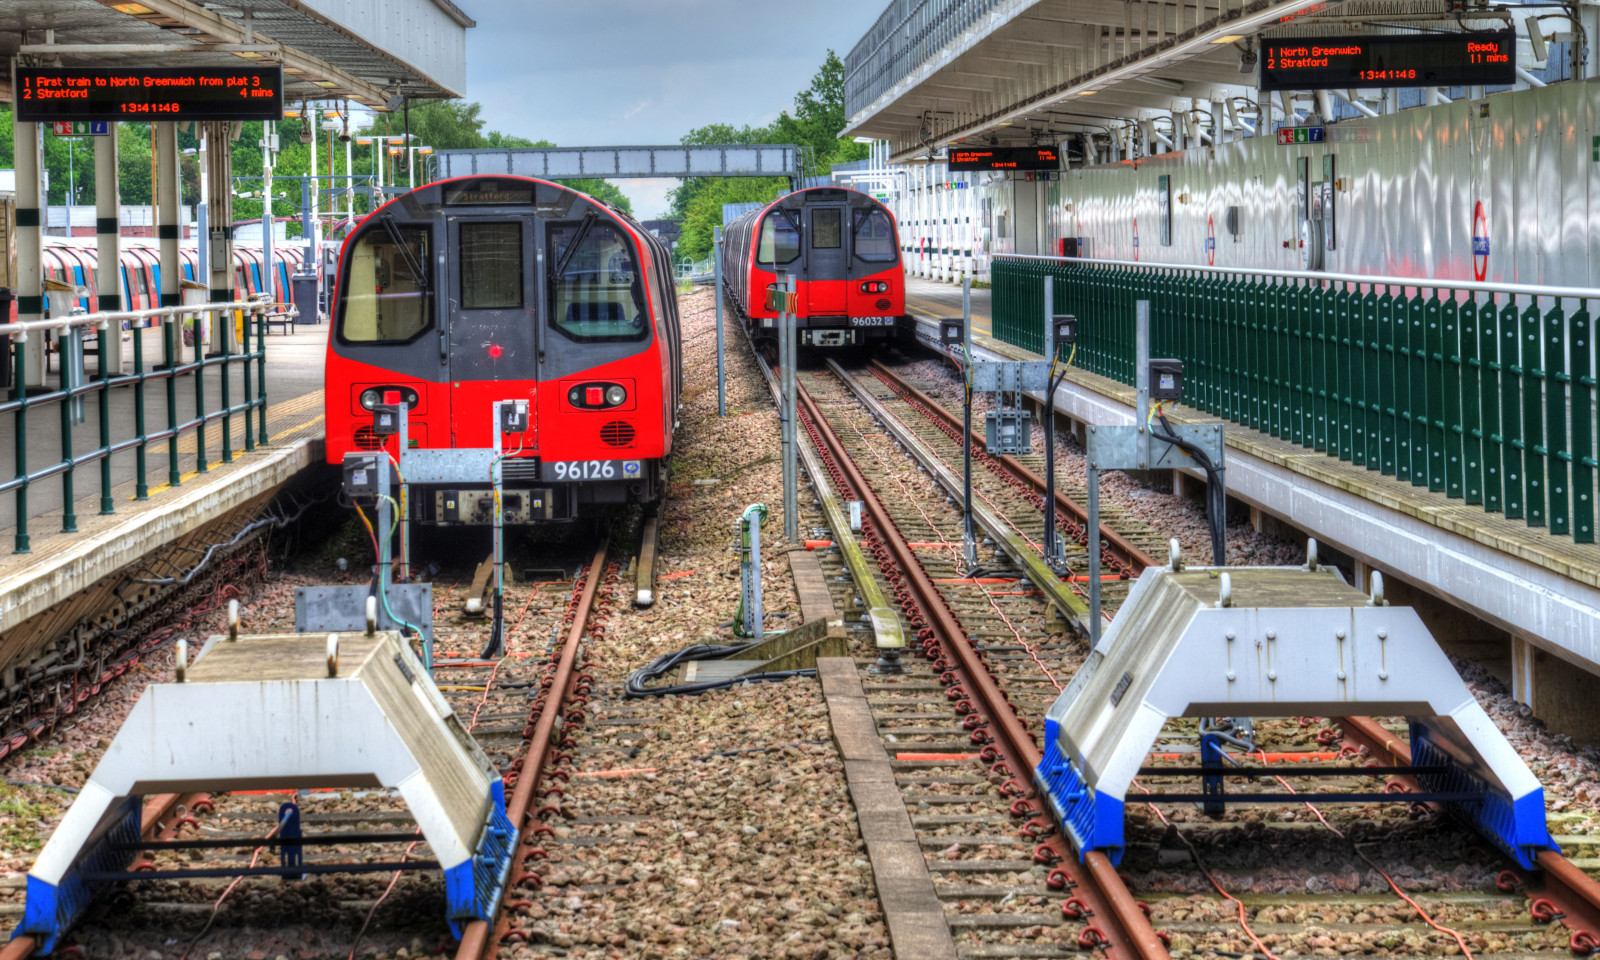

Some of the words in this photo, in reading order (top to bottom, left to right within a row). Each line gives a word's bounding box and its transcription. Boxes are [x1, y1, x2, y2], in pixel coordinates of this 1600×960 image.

[1269, 47, 1274, 58] 1
[1280, 46, 1309, 58] North
[1311, 45, 1362, 57] Greenwich
[1467, 41, 1499, 54] Ready
[1267, 58, 1275, 69] 2
[1280, 57, 1329, 69] Stratford
[1470, 53, 1482, 64] 11
[1486, 52, 1509, 63] mins
[1359, 69, 1416, 80] 13:41:48
[24, 77, 30, 87] 1
[36, 77, 63, 87] First
[66, 77, 91, 87] train
[95, 77, 107, 87] to
[110, 77, 140, 87] North
[142, 76, 196, 87] Greenwich
[199, 76, 224, 87] from
[226, 76, 248, 88] plat
[251, 76, 261, 87] 3
[23, 88, 32, 99] 2
[36, 88, 88, 99] Stratford
[239, 88, 248, 98] 4
[251, 88, 274, 98] mins
[120, 102, 180, 113] 13:41:48
[463, 193, 510, 201] Stratford
[852, 316, 882, 326] 96032
[554, 459, 615, 480] 96126
